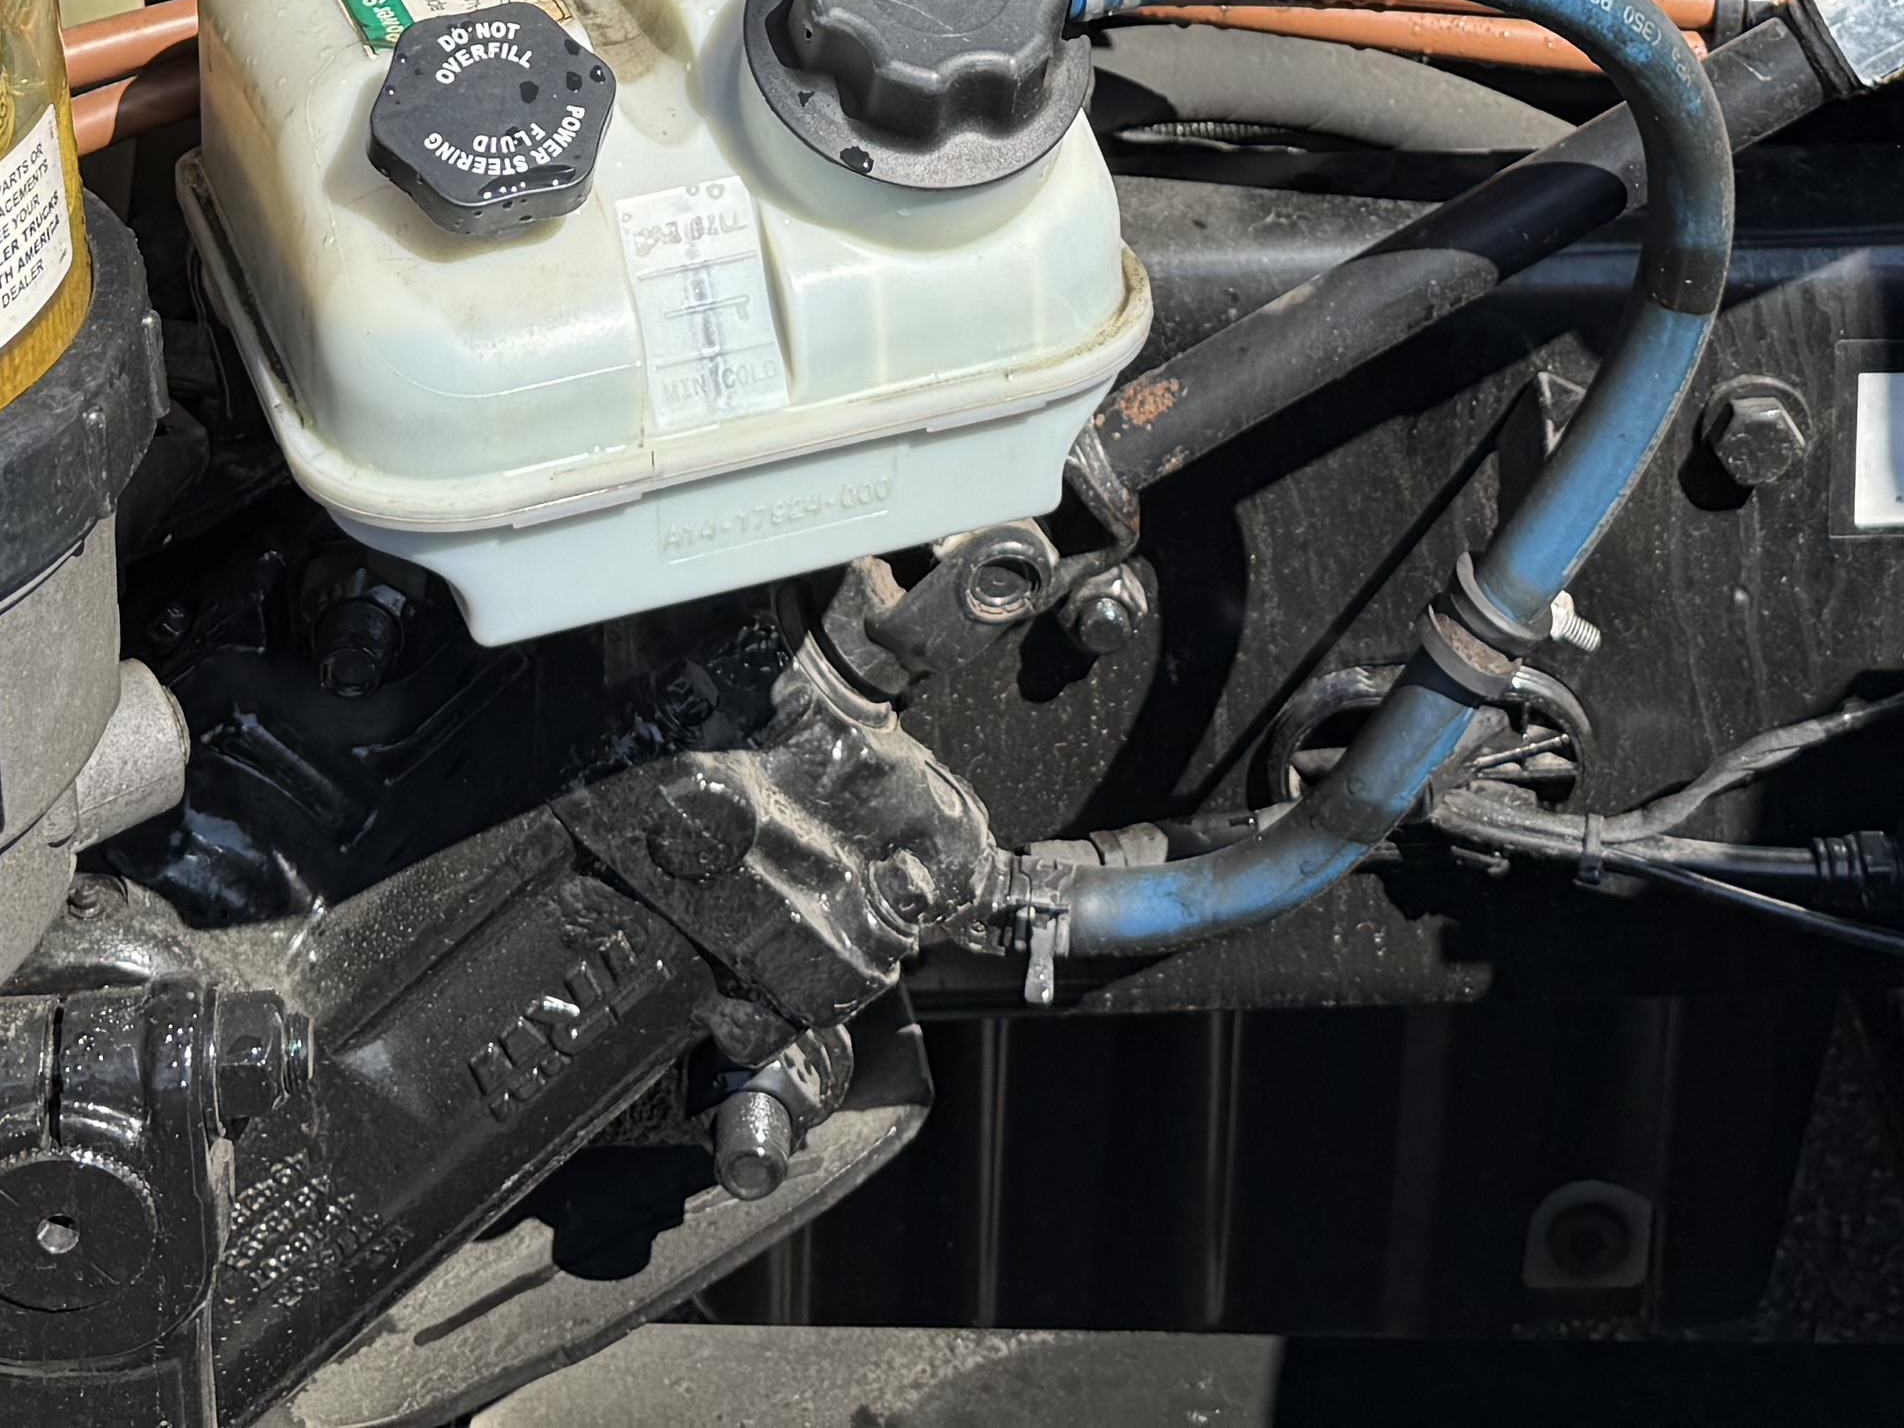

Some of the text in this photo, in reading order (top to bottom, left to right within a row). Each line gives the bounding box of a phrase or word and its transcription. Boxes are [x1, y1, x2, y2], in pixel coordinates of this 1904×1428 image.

[437, 21, 521, 53] DO NOT
[1623, 5, 1662, 46] (350
[435, 42, 533, 85] OVERFILL
[30, 142, 44, 164] OR
[423, 104, 586, 175] POWER STEERING
[472, 122, 546, 154] FLUID
[12, 194, 41, 230] YOUR
[21, 190, 61, 243] TRUCKS
[17, 214, 61, 273] AMERICA
[1, 259, 46, 309] DEALER
[661, 359, 778, 403] MIN COLD
